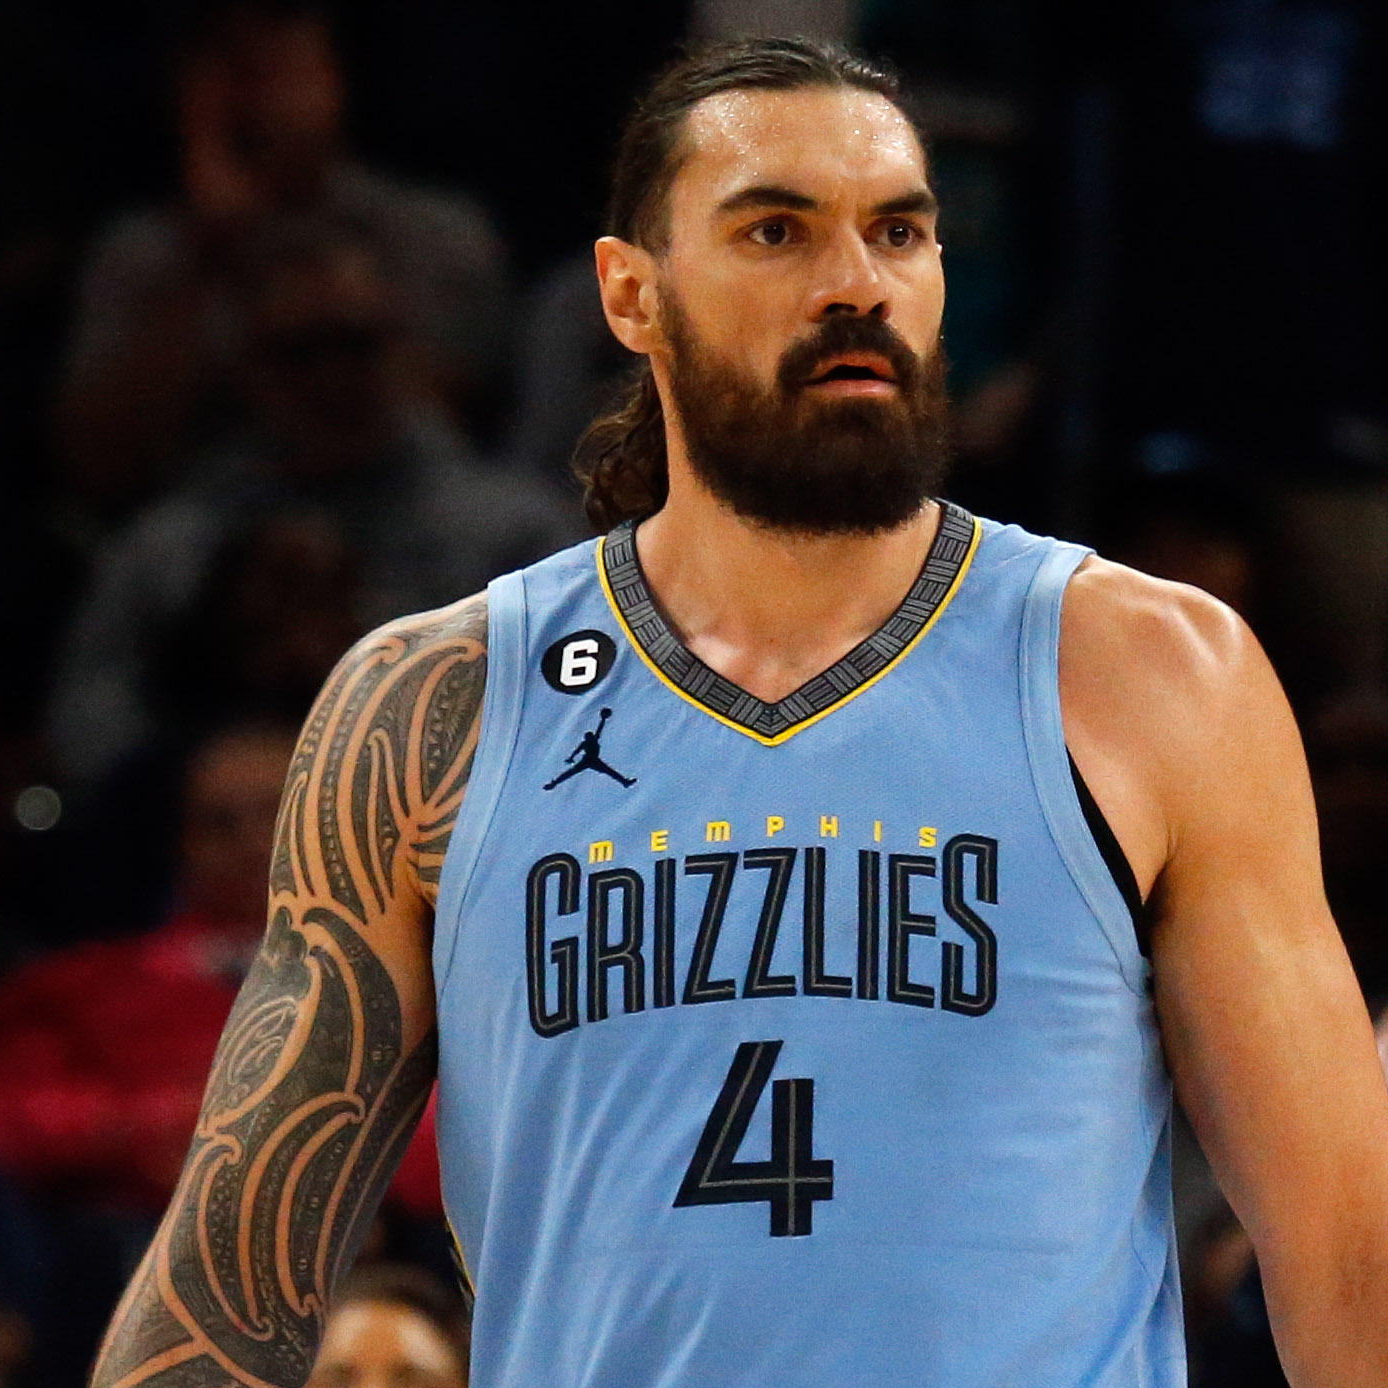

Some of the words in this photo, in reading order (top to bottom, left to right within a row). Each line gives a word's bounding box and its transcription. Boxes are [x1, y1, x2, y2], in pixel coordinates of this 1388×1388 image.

[559, 638, 599, 687] 6
[588, 815, 937, 864] MEMPHIS
[525, 833, 1000, 1040] GRIZZLIES
[672, 1039, 834, 1238] 4
